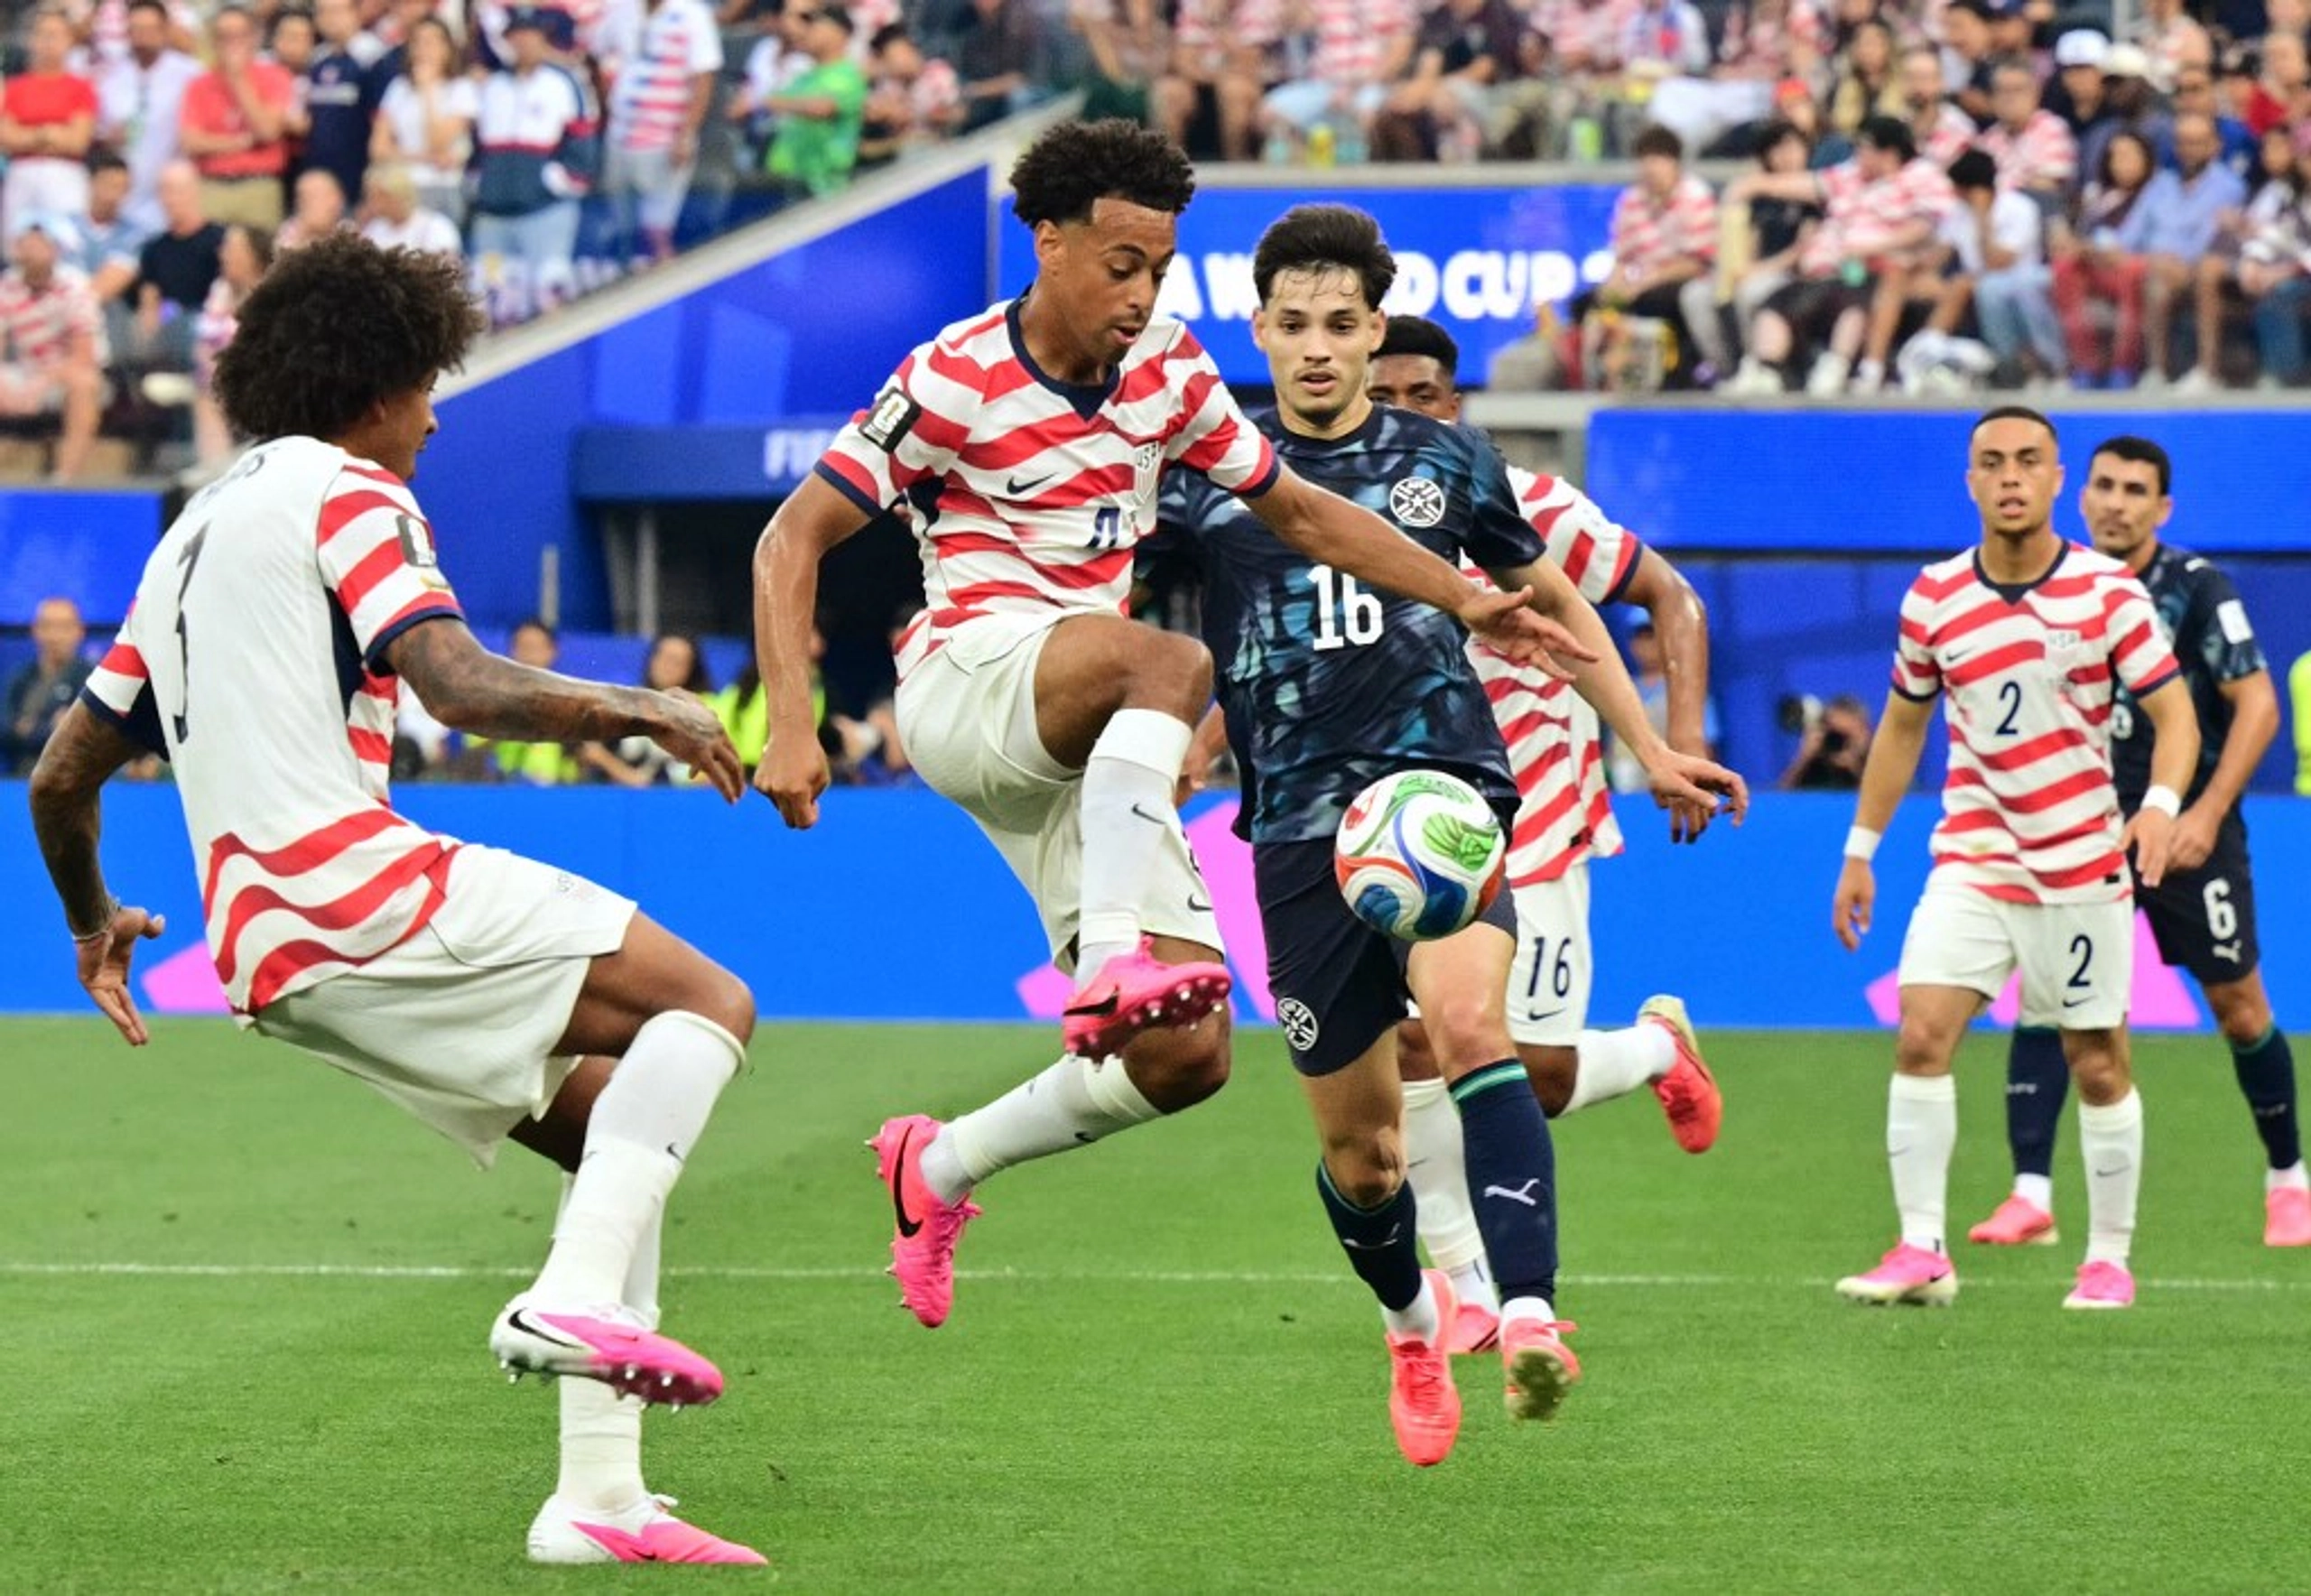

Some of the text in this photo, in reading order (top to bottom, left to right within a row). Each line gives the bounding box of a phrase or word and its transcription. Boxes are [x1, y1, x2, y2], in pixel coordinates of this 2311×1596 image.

[1443, 250, 1576, 320] CUP
[1305, 563, 1385, 652] 16
[1995, 679, 2022, 736] 2
[2203, 877, 2238, 941] 6
[1527, 936, 1573, 999] 16
[2067, 933, 2093, 988] 2
